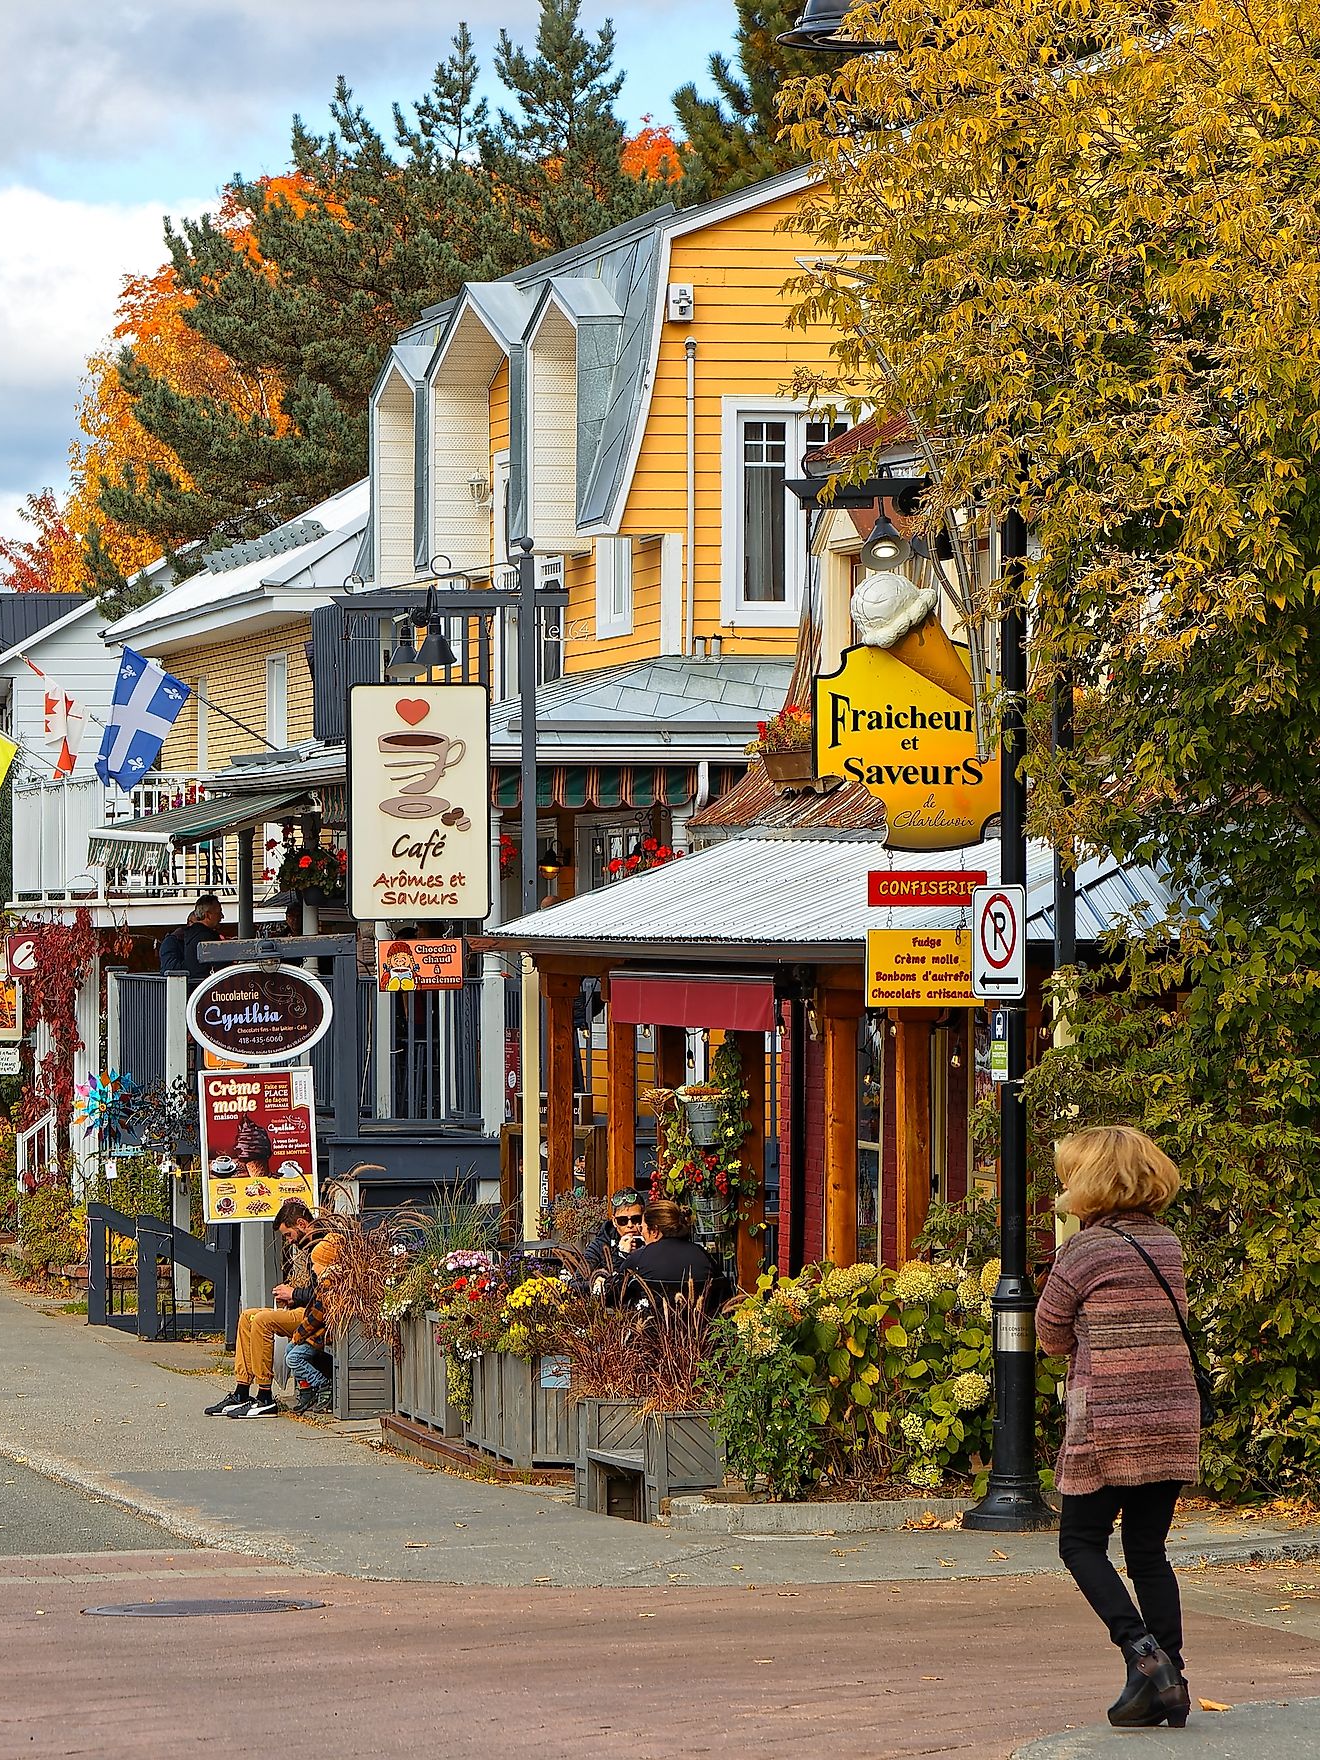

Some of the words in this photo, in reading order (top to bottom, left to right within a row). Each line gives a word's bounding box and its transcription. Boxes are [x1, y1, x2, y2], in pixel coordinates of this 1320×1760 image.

[828, 691, 974, 749] Fraicheur
[901, 736, 919, 751] et
[923, 793, 936, 809] de
[893, 810, 975, 828] Charlevoix
[391, 828, 447, 870] Café
[373, 869, 444, 889] Arômes
[449, 872, 466, 887] et
[879, 880, 977, 896] CONFISERIE
[415, 944, 457, 954] Chocolat
[911, 936, 942, 949] Fudge
[423, 955, 452, 964] chaud
[894, 953, 927, 965] Crème
[931, 953, 960, 965] molle
[433, 965, 441, 974] à
[875, 970, 917, 982] Bonbons
[414, 975, 461, 984] l'ancienne
[211, 989, 260, 1002] Chocolaterie
[871, 988, 921, 999] Chocolats
[204, 1002, 284, 1031] Cynthia
[208, 1078, 261, 1097] Crème
[264, 1089, 289, 1097] PLACE
[212, 1095, 257, 1113] molle
[213, 1113, 239, 1121] maison
